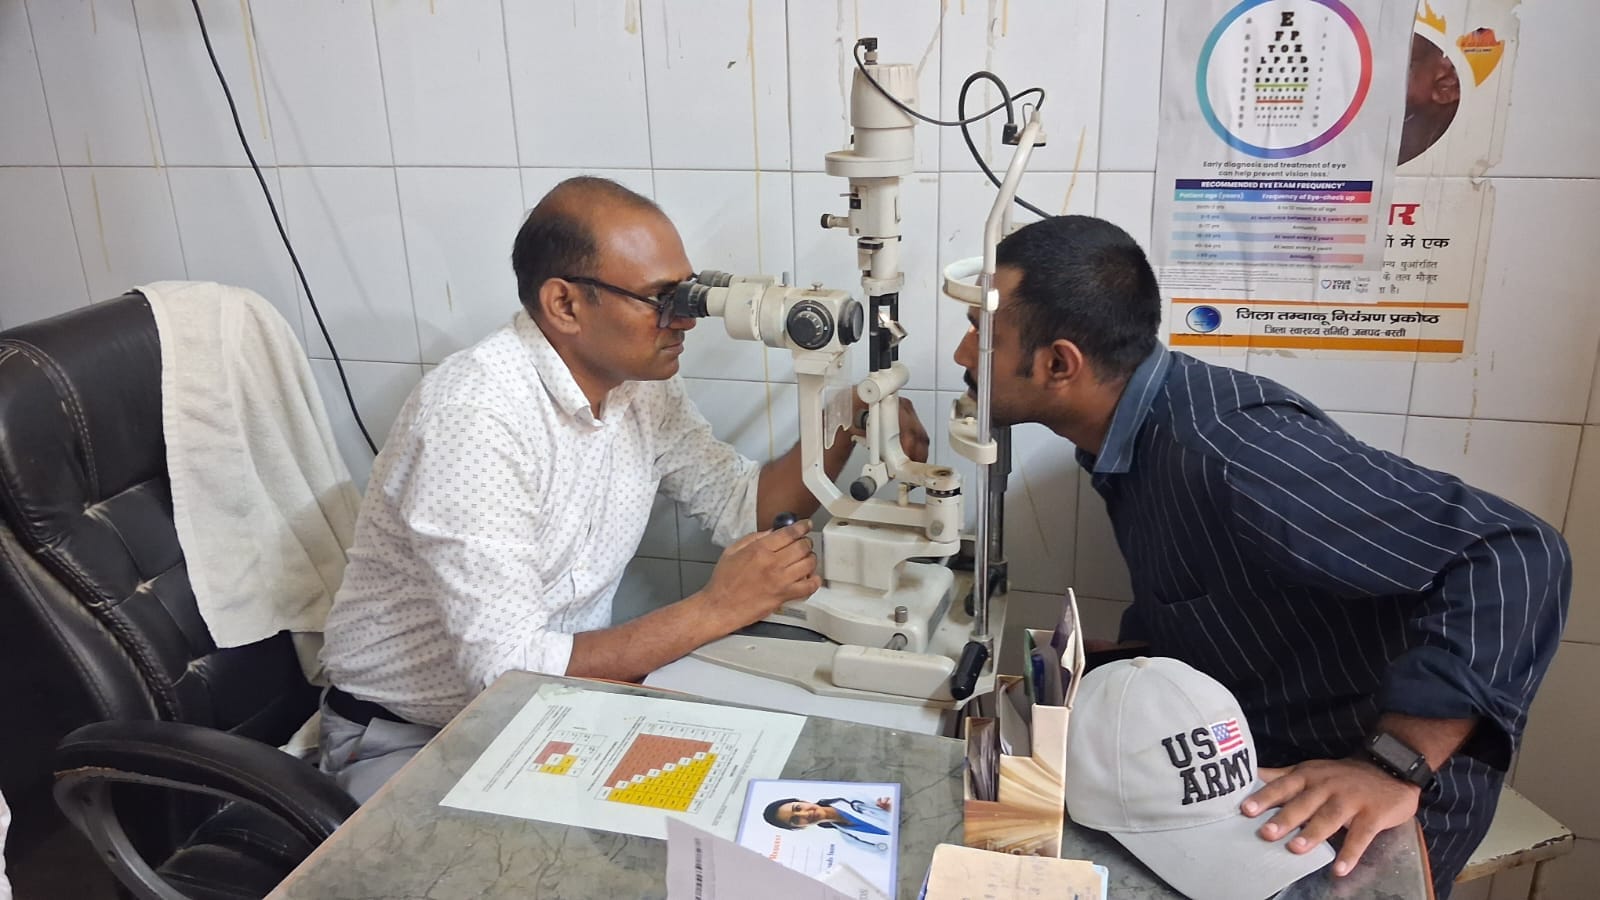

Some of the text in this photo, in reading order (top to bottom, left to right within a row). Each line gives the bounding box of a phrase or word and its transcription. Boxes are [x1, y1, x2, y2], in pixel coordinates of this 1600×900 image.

[1280, 11, 1294, 26] E
[1400, 234, 1416, 248] में
[1422, 238, 1450, 249] एक
[1416, 272, 1438, 284] मौजूद
[1236, 307, 1440, 325] जिला तम्बाकू नियंत्रण प्रकोष्ठ
[1265, 324, 1406, 337] जिला स्वास्थ्य समिति जनपद-बस्ती
[1162, 727, 1217, 768] US
[1180, 748, 1252, 805] ARMY
